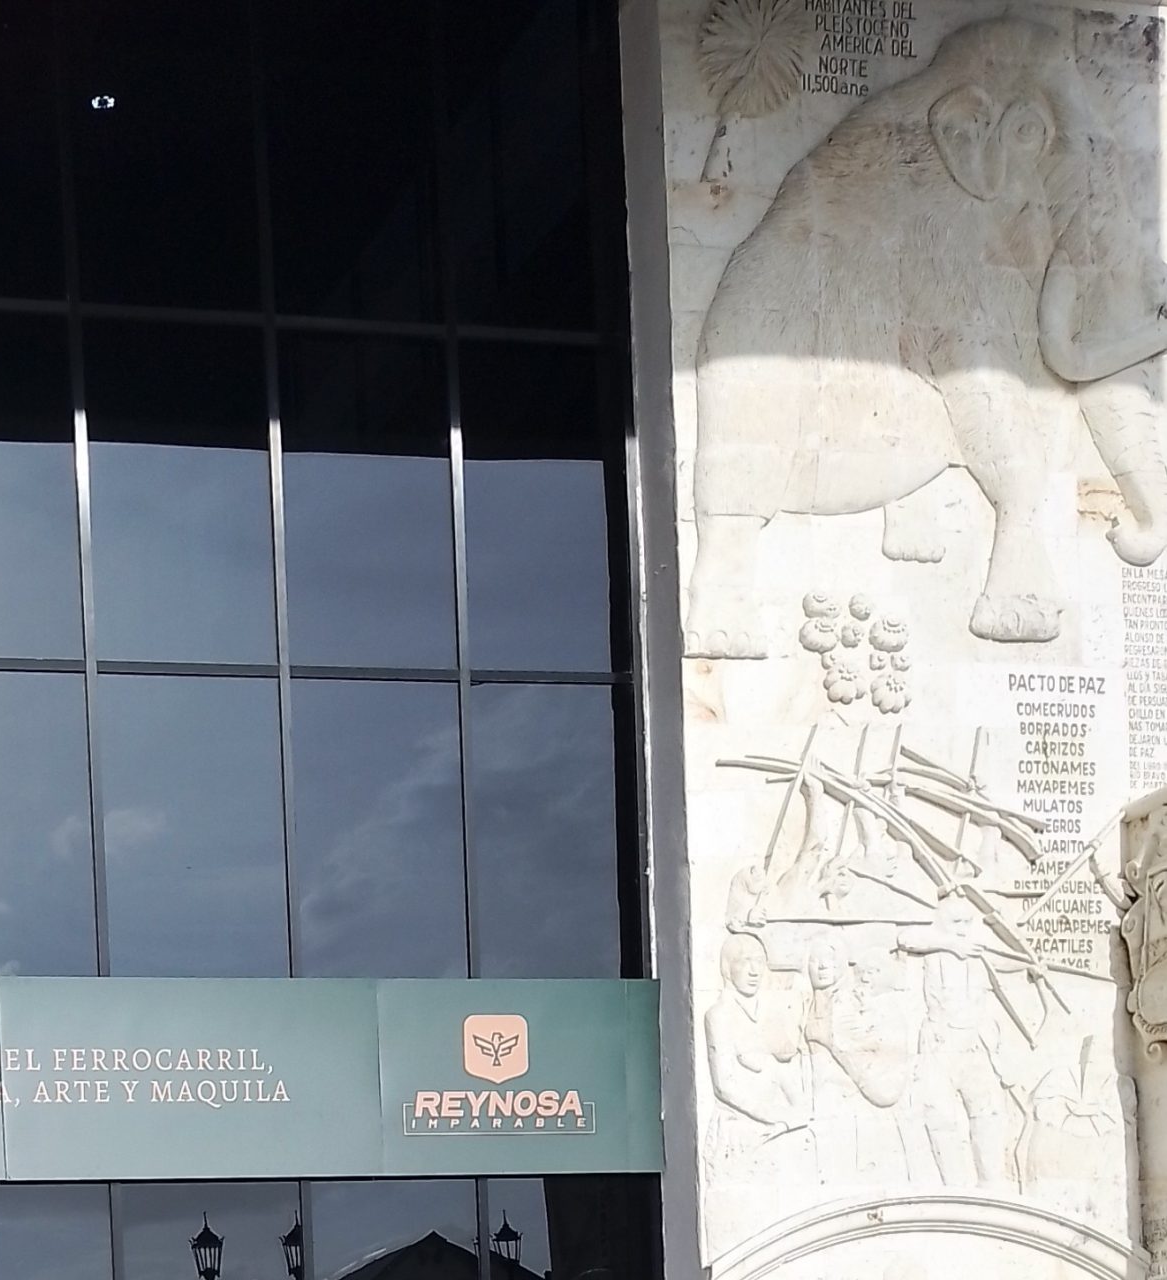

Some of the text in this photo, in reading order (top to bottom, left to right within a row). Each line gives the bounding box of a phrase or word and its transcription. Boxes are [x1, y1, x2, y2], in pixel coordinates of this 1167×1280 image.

[804, 0, 916, 20] HABITANTES DEL
[815, 14, 910, 39] PLEISTOCENO
[891, 39, 917, 58] DEL
[818, 56, 868, 77] NORTE
[1008, 673, 1106, 695] PACTO DE PAZ
[1016, 702, 1096, 718] COMECRUDOS
[1020, 722, 1088, 738] BORRADOS
[1025, 740, 1086, 757] CARRIZOS
[1018, 759, 1096, 776] COTONAMES
[1016, 779, 1095, 796] MAYAPEMES
[1022, 799, 1083, 814] MULATOS
[52, 1047, 274, 1075] FERROCARRIL,
[33, 1080, 111, 1103] ARTE
[120, 1080, 139, 1103] Y
[150, 1080, 291, 1108] MAQUILA
[414, 1089, 584, 1118] REYNOSA
[411, 1117, 587, 1129] IMPARABLE
